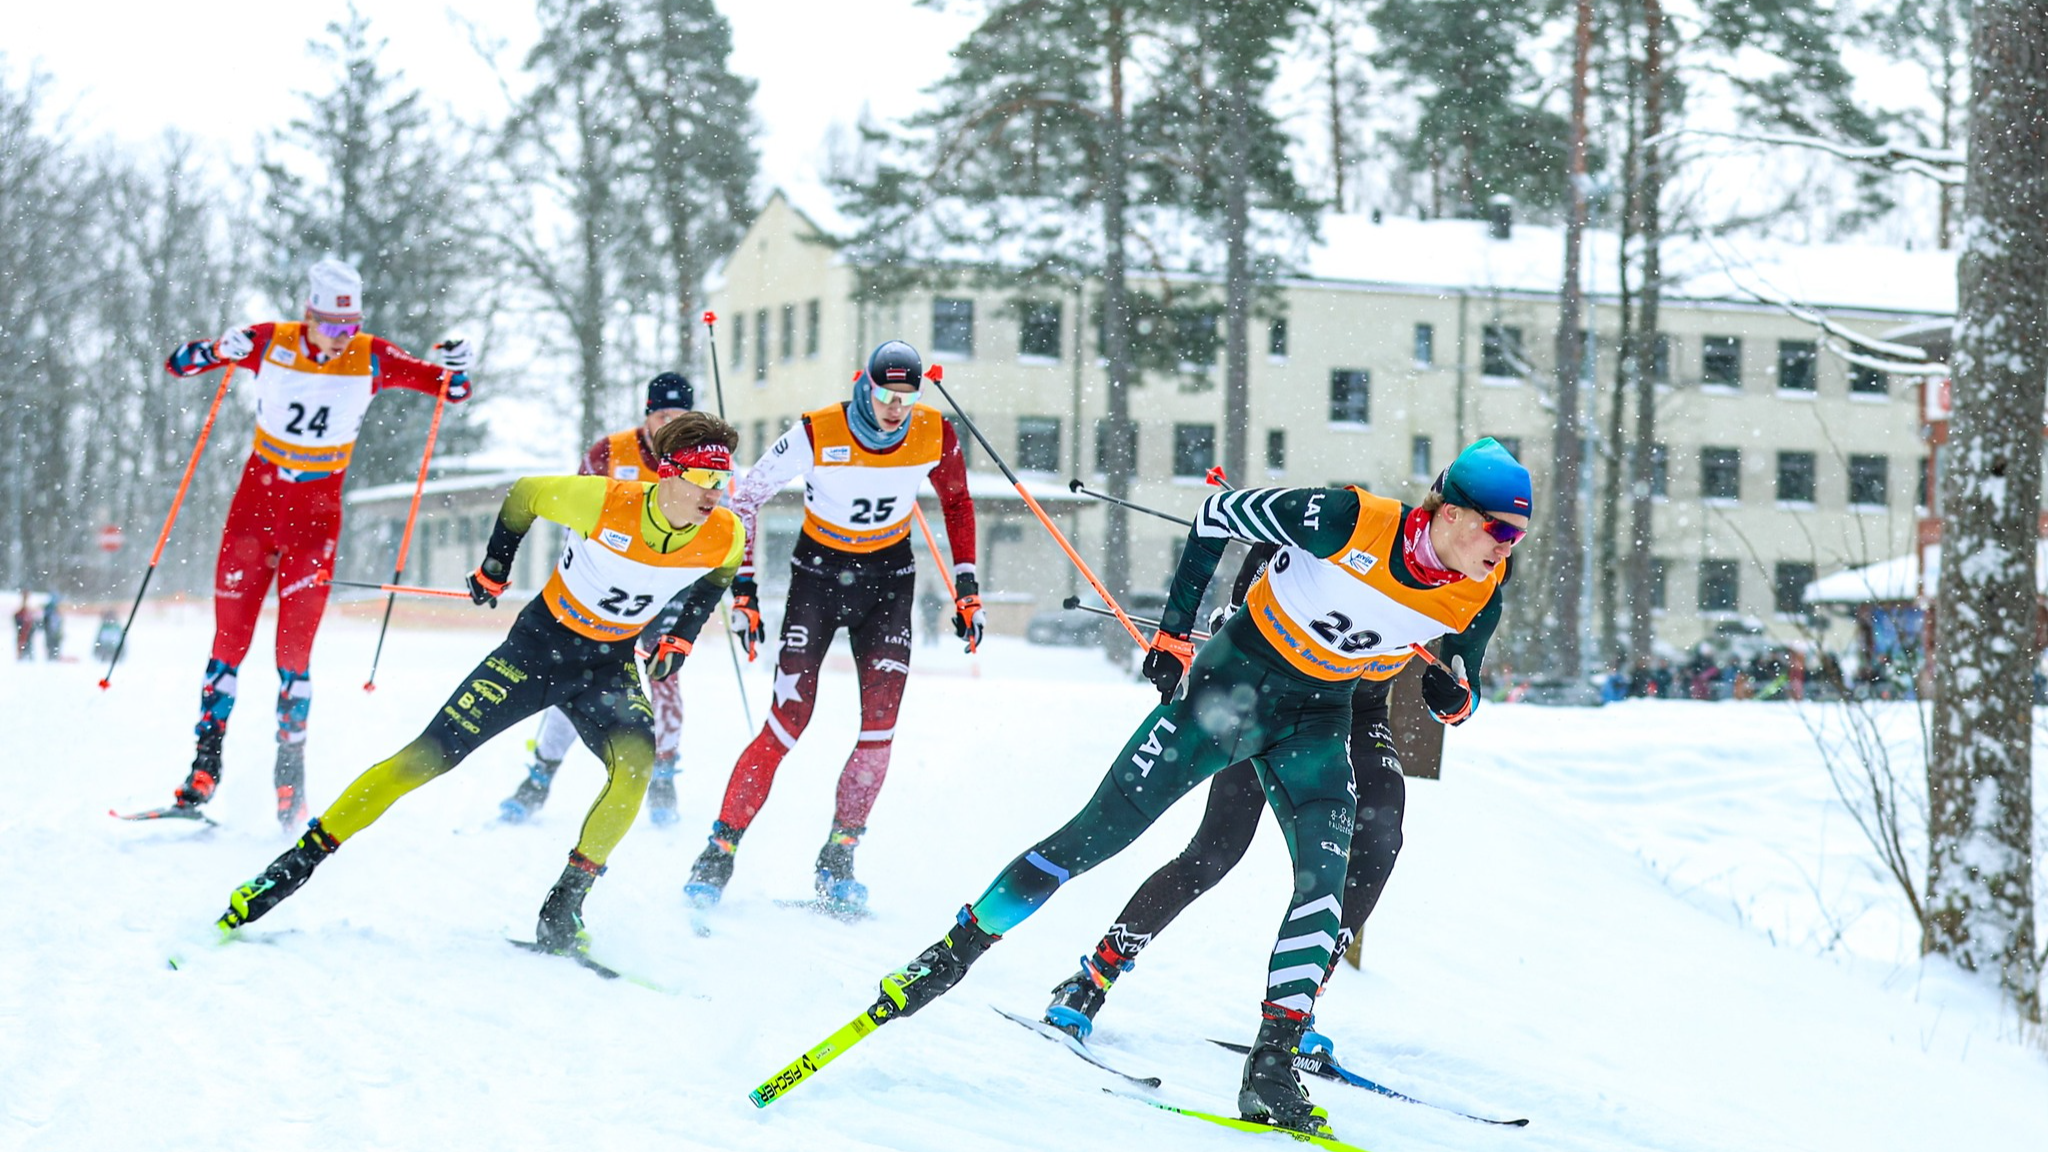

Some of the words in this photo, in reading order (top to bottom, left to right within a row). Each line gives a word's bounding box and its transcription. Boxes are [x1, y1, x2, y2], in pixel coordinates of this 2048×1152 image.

[285, 402, 330, 438] 24
[850, 497, 897, 525] 25
[1303, 494, 1326, 531] LAT
[597, 586, 654, 617] 23
[1131, 716, 1177, 778] LAT
[757, 1063, 803, 1102] FISCHER
